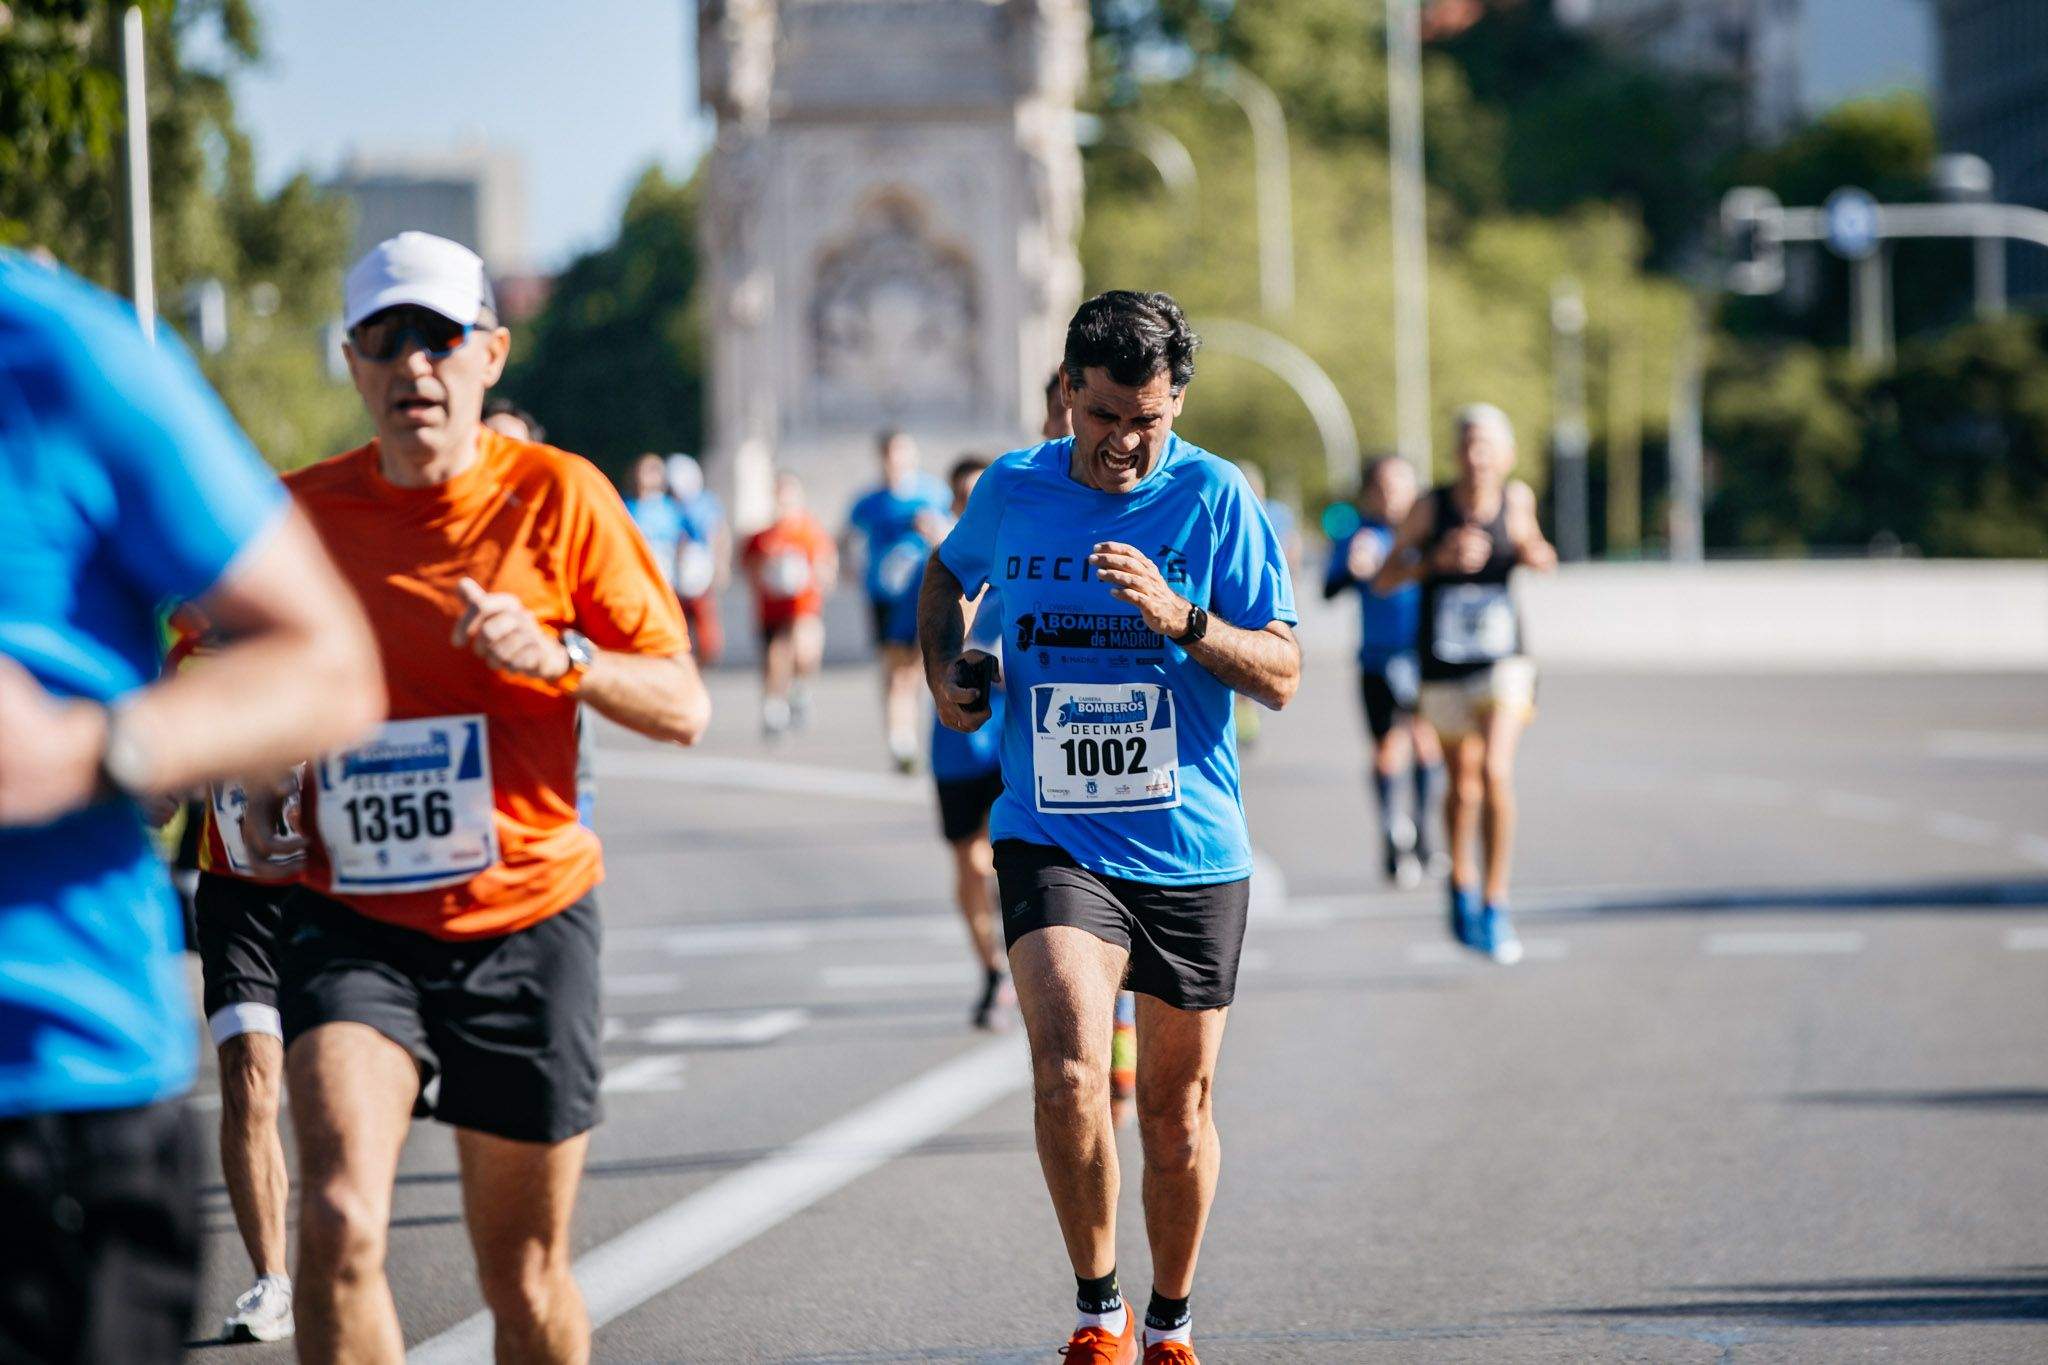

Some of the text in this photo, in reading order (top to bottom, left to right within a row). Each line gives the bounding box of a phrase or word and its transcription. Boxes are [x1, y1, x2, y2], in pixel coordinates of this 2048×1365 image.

[1006, 555, 1187, 584] DECIS
[1048, 615, 1150, 632] BOMBERO
[1091, 632, 1161, 648] de MADRID
[1078, 701, 1145, 714] BOMBEROS
[1071, 723, 1145, 735] DECIMAS
[1060, 736, 1148, 776] 1002
[343, 789, 454, 845] 1356
